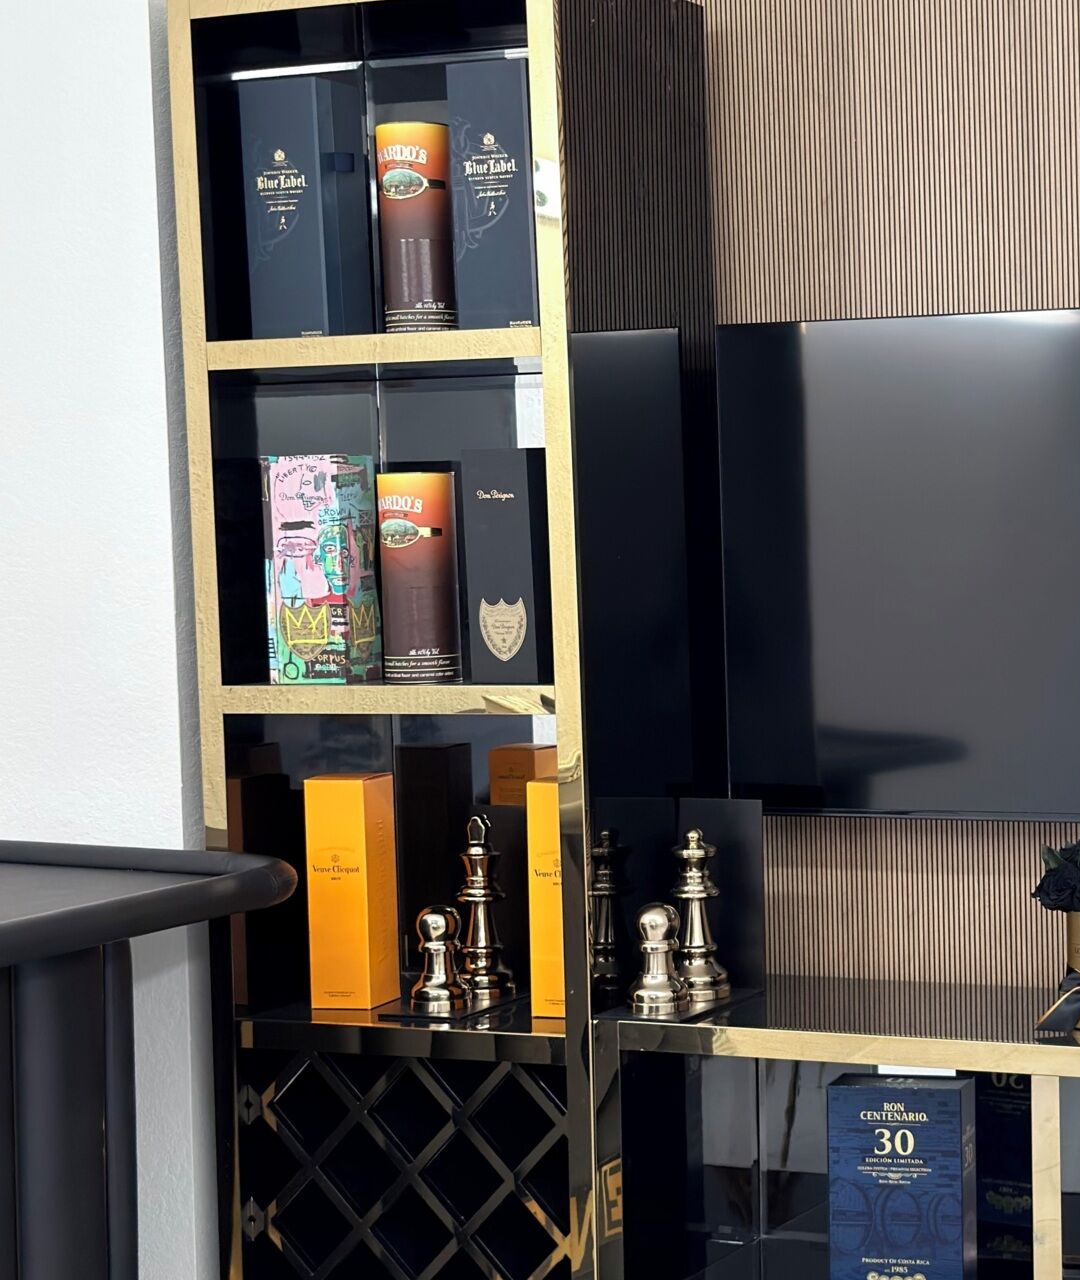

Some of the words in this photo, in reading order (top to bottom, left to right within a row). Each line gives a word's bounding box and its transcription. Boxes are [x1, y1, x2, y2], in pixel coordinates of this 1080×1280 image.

[463, 160, 488, 176] Blue
[256, 176, 279, 191] Blue
[476, 489, 491, 500] Dom
[379, 494, 423, 514] ARDO'S
[312, 864, 332, 873] Veuve
[332, 864, 360, 875] Clicquot
[534, 868, 553, 878] Veuve
[883, 1102, 905, 1112] RON
[860, 1111, 927, 1122] CENTENARIO
[874, 1128, 915, 1156] 30
[865, 1156, 892, 1164] EDICIÓN
